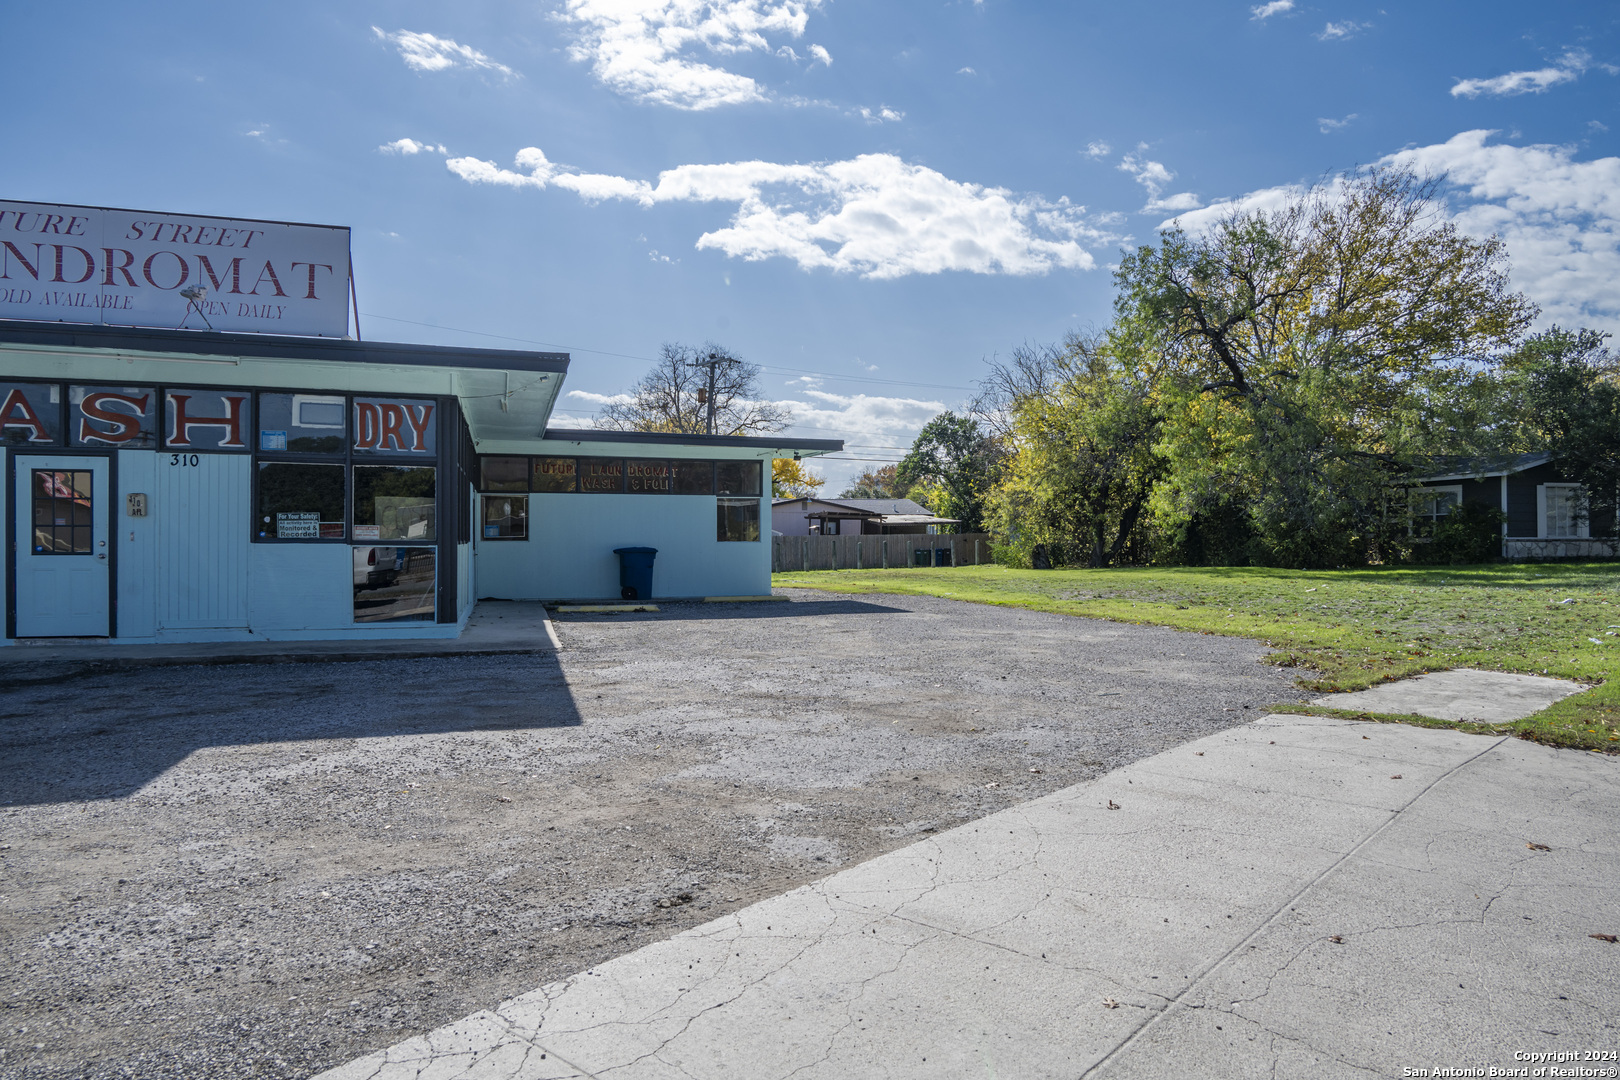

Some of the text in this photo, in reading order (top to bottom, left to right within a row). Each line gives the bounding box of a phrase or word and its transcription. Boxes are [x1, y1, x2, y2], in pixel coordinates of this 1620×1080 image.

[126, 220, 265, 249] STREET
[39, 290, 134, 310] AVAILABLE
[186, 299, 287, 320] OPEN DAILY
[353, 402, 434, 453] DRY
[170, 453, 199, 467] 310
[580, 476, 615, 489] WASH
